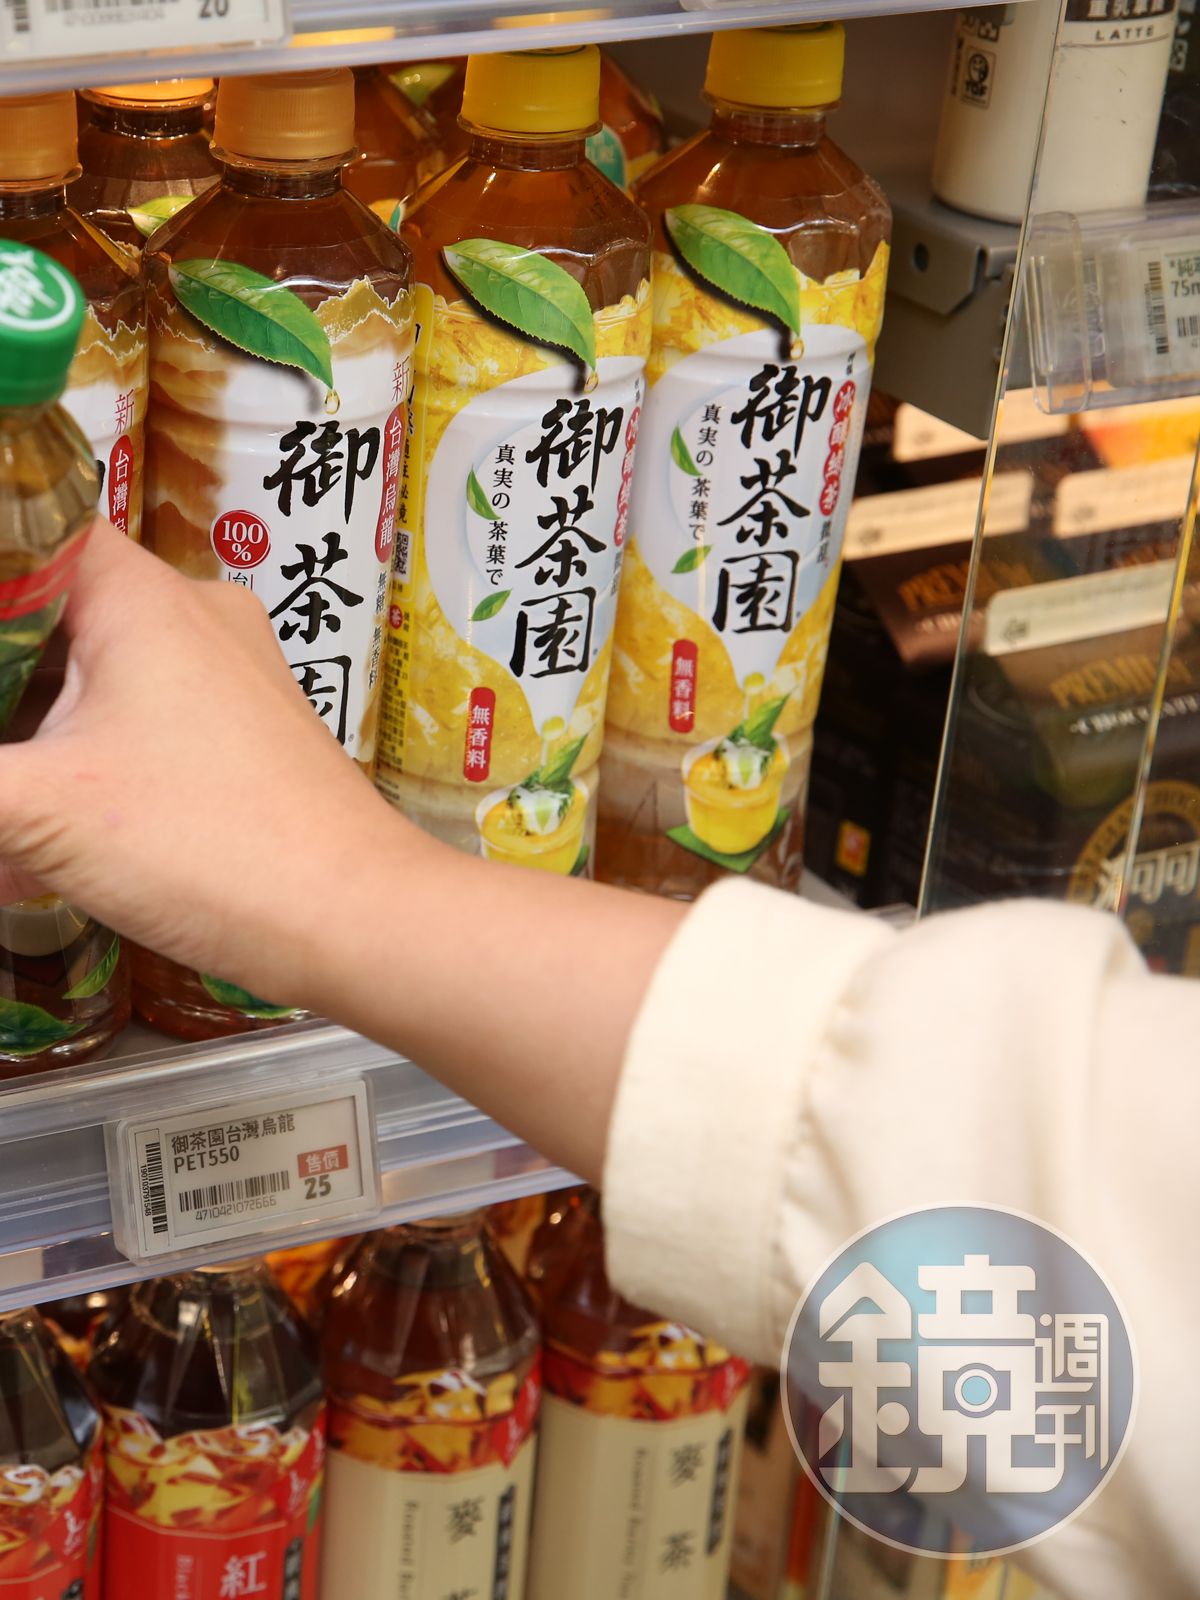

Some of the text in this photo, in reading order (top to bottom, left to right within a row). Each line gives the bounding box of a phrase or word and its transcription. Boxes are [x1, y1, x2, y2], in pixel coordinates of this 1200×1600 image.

[1095, 25, 1155, 41] LATTE
[392, 355, 410, 402] 新
[115, 388, 134, 434] 新
[379, 415, 402, 550] 台灣烏龍
[688, 404, 721, 541] 真実の 茶葉で
[486, 444, 515, 586] 真実の 茶葉で
[711, 363, 833, 635] 御茶園
[221, 520, 264, 562] 100%
[509, 398, 625, 680] 御茶園
[672, 656, 695, 720] 無香料
[467, 704, 490, 769] 無香料
[171, 1113, 296, 1156] 御茶園台灣烏龍
[173, 1145, 240, 1174] PET550
[305, 1151, 340, 1172] 售價
[195, 1195, 277, 1222] 4710421072666
[304, 1175, 332, 1200] 25
[220, 1551, 268, 1600] 紅
